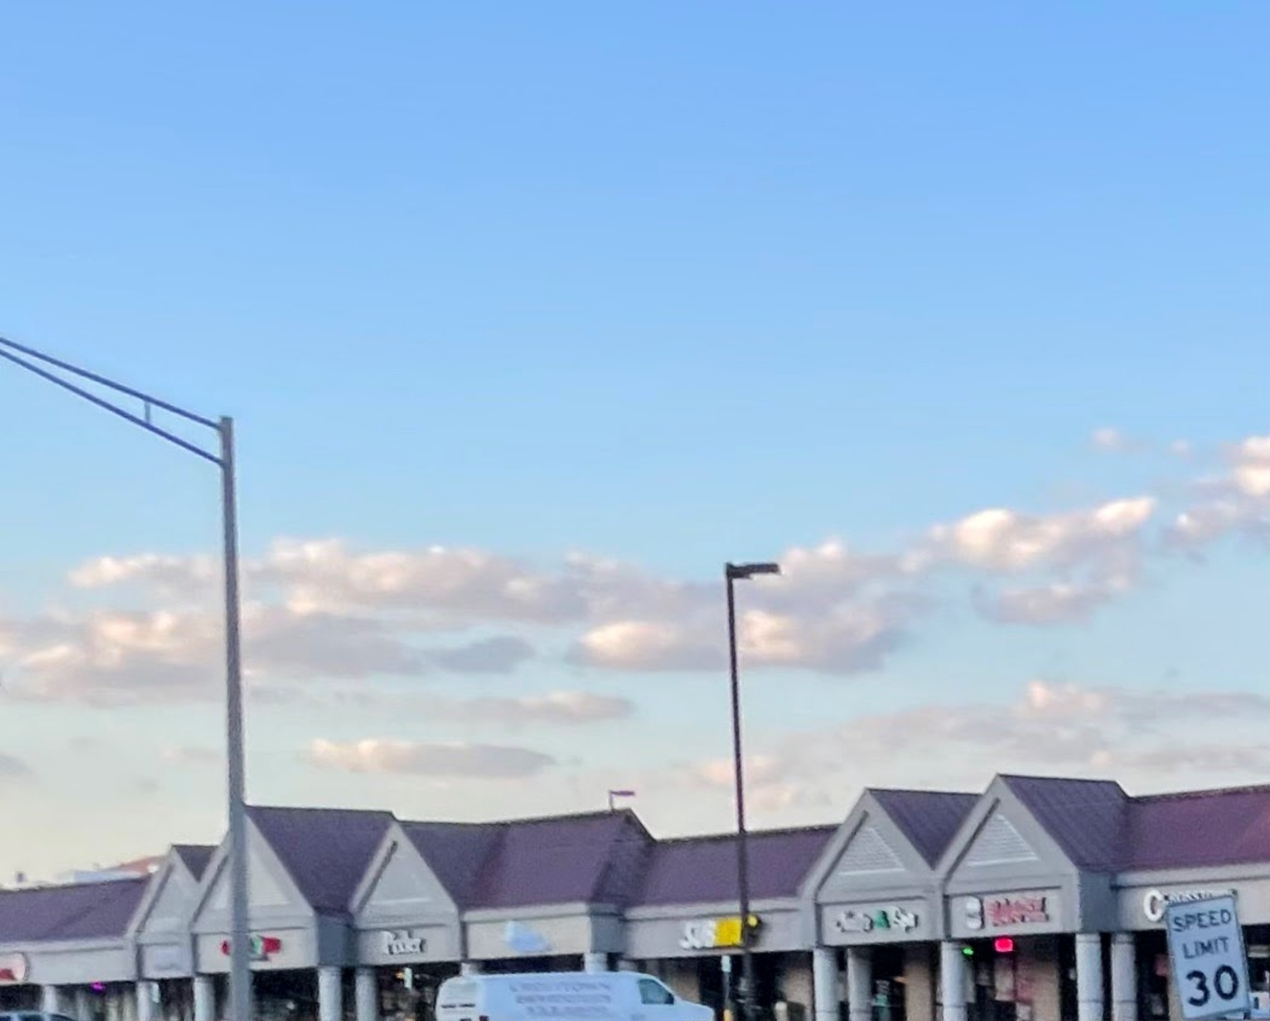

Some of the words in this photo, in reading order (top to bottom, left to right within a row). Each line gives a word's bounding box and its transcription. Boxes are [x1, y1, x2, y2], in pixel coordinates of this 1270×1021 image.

[1173, 909, 1232, 932] SPEED
[1182, 936, 1229, 959] LIMIT
[1185, 964, 1239, 1007] 30
